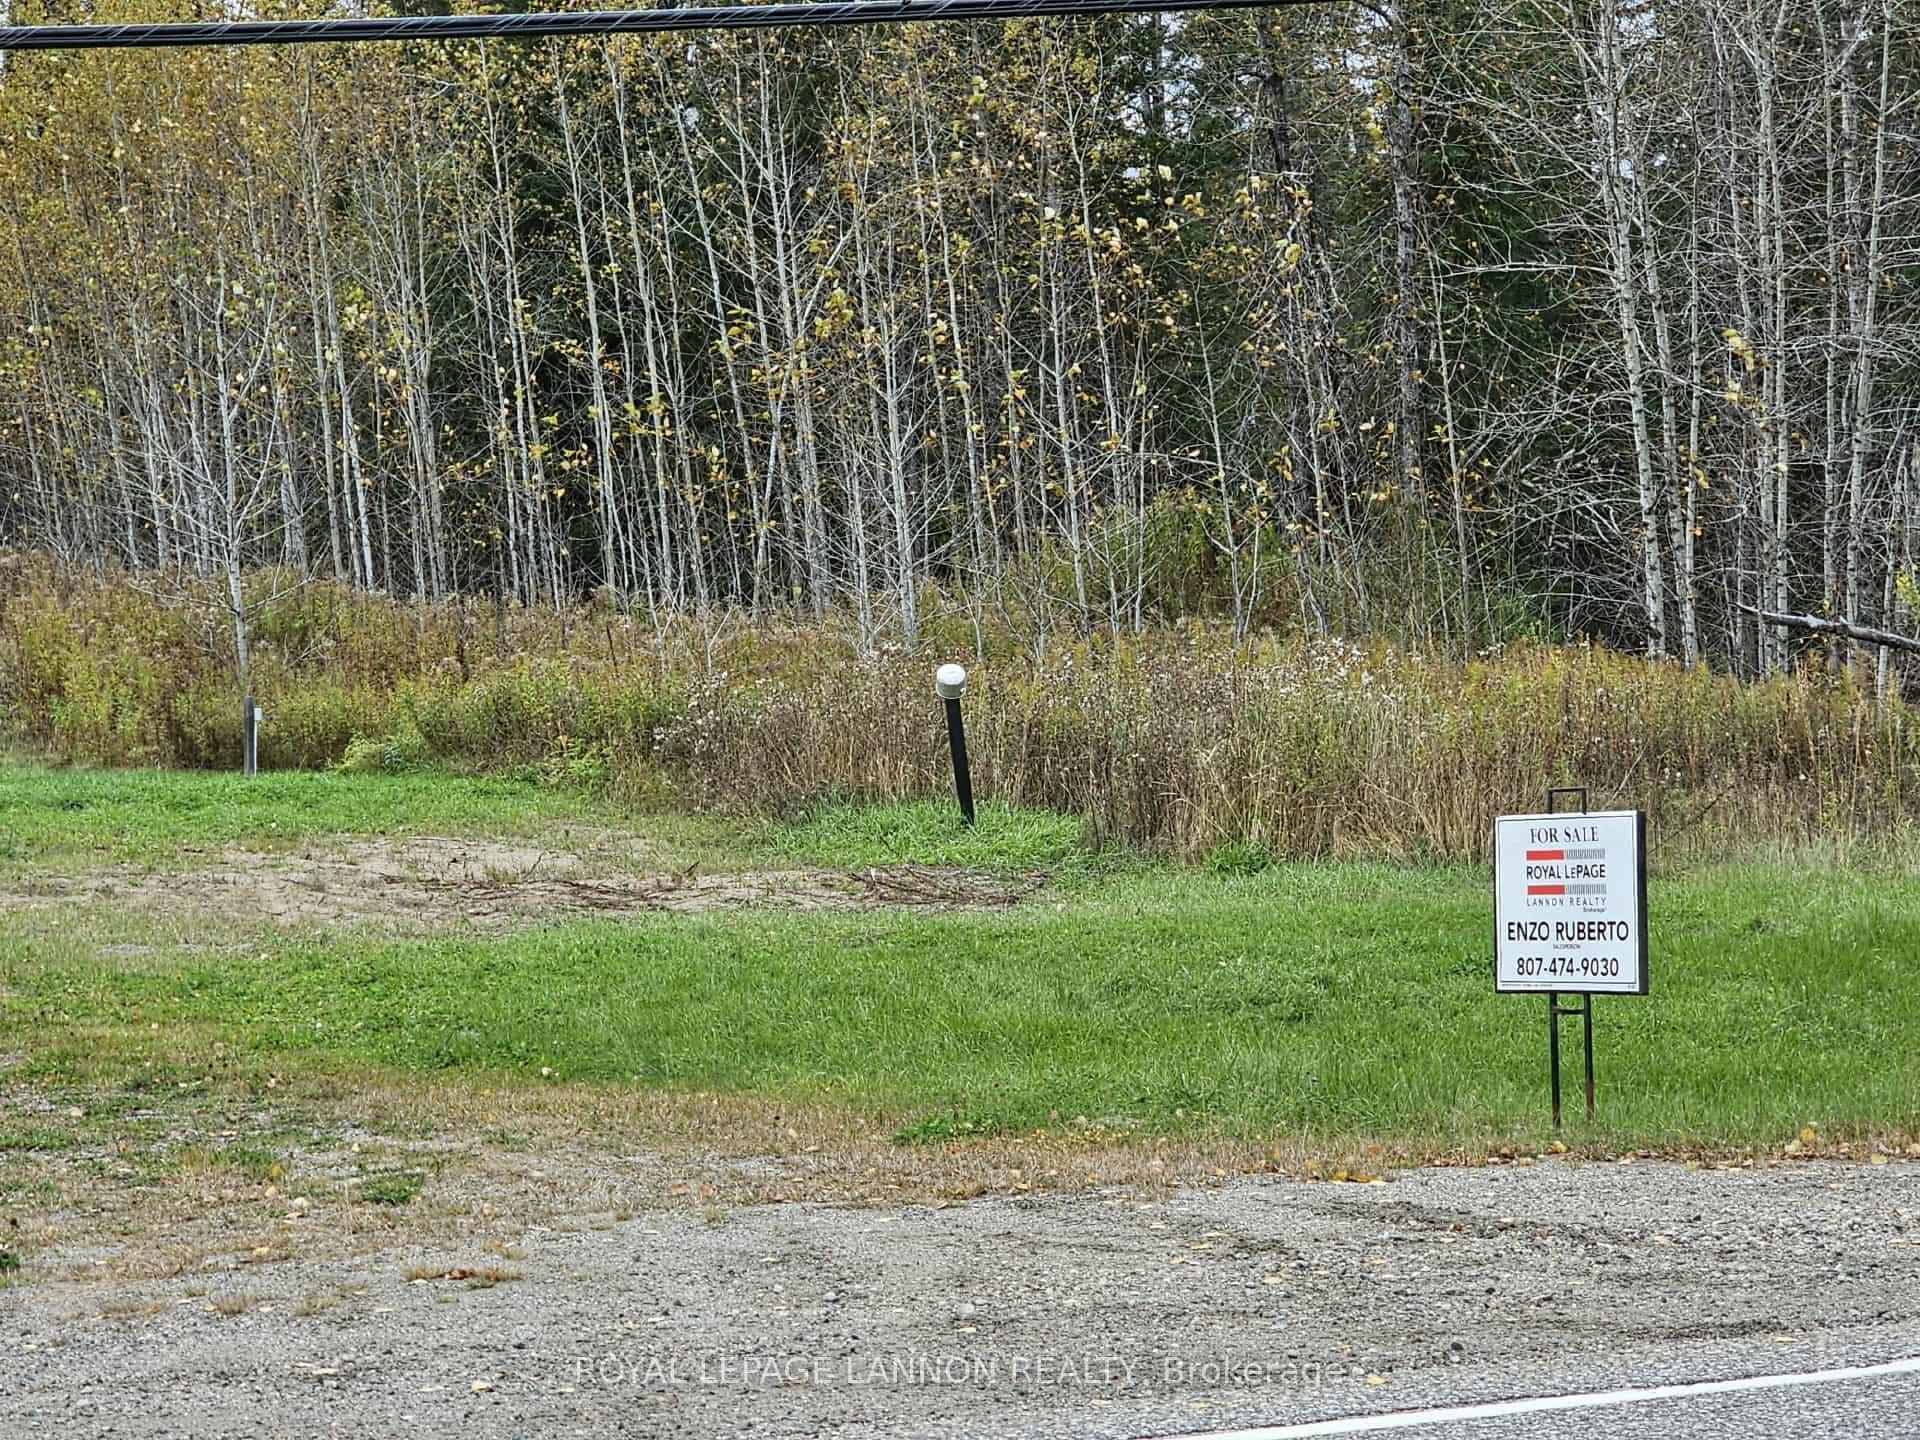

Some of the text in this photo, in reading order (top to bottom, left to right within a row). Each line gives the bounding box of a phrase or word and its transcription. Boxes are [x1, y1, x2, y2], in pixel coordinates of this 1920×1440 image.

[1530, 826, 1599, 844] FOR SALE
[1526, 865, 1562, 880] ROYAL
[1526, 897, 1607, 907] LANNON REALTY
[1507, 920, 1629, 941] ENZO RUBERTO
[1516, 957, 1619, 977] 807-474-9030
